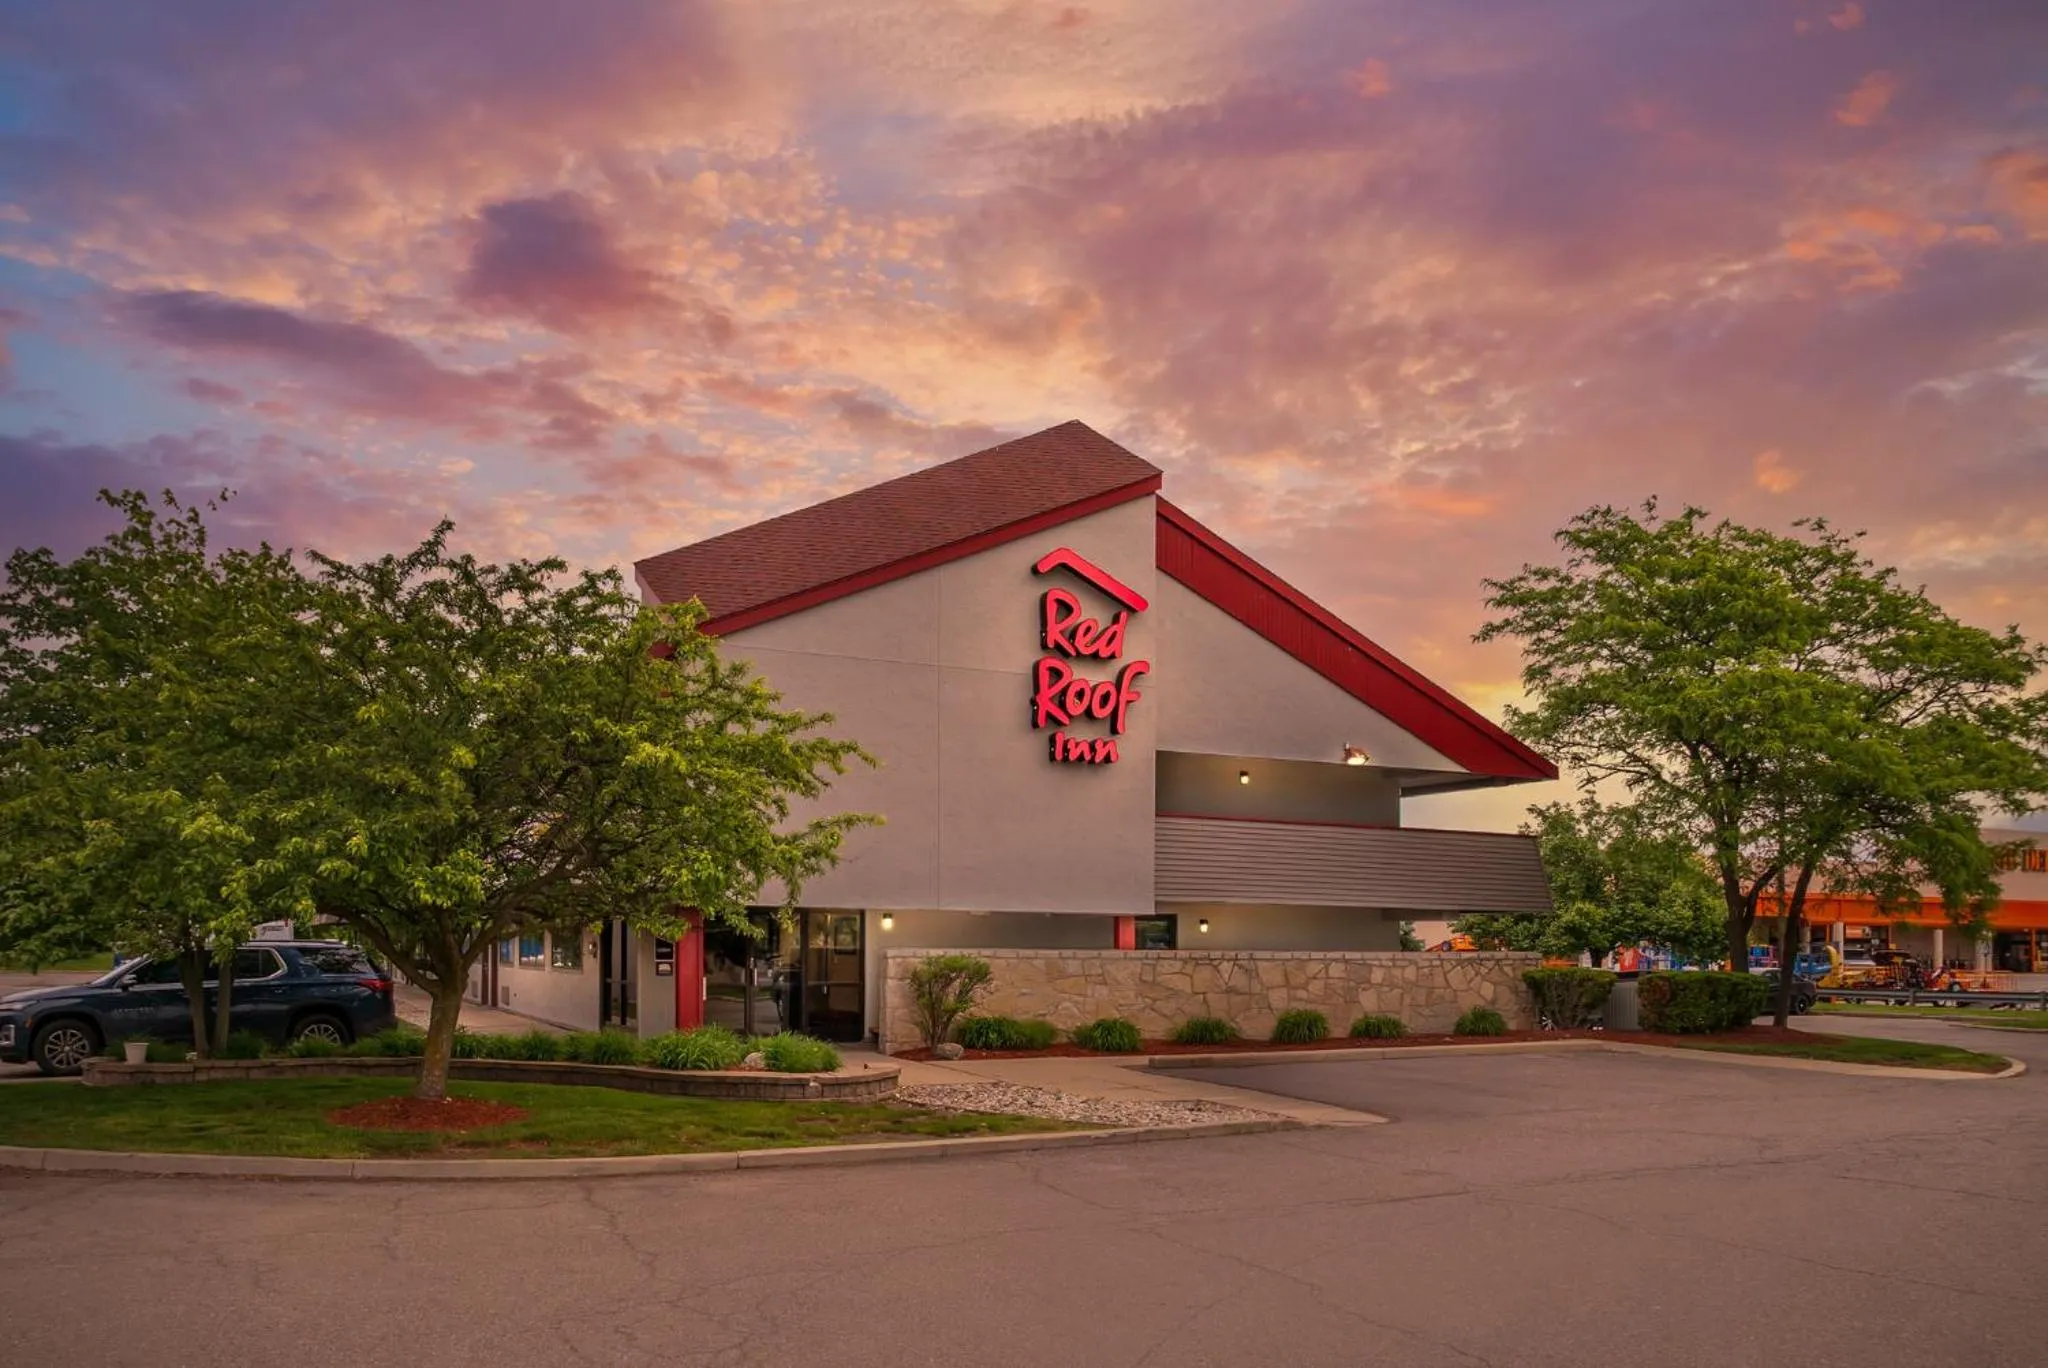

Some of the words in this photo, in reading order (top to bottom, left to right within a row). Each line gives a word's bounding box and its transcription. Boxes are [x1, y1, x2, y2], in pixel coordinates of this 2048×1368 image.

[1040, 587, 1129, 659] Red
[1031, 656, 1150, 735] Roof
[1049, 731, 1119, 764] Inn
